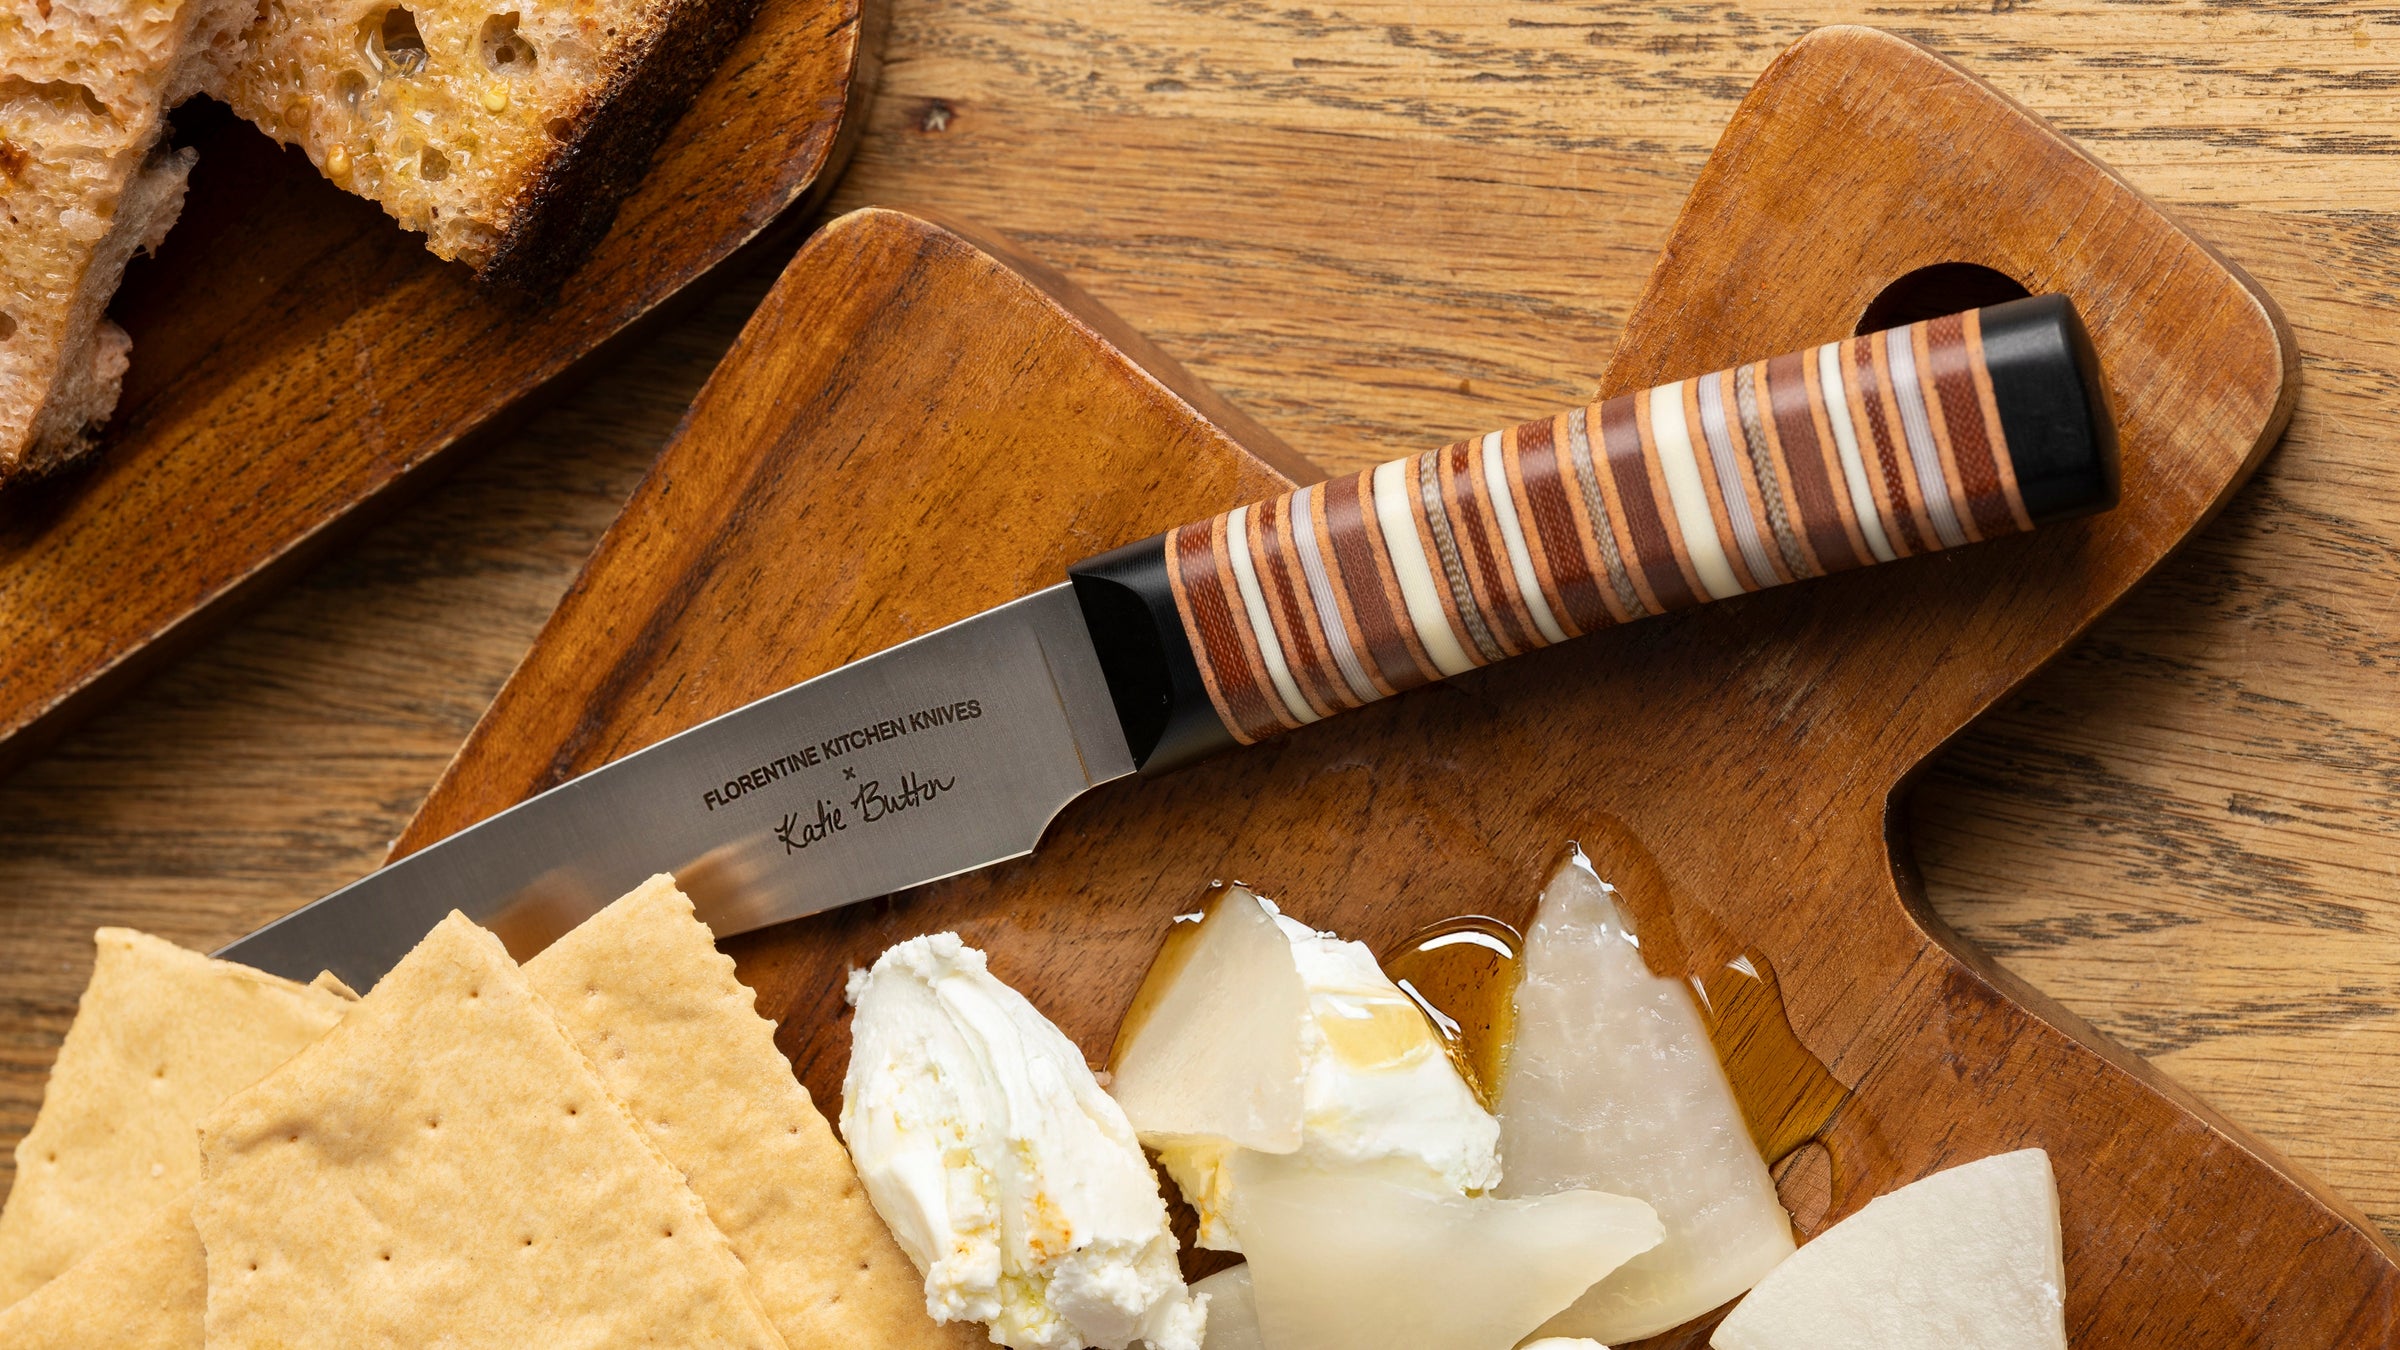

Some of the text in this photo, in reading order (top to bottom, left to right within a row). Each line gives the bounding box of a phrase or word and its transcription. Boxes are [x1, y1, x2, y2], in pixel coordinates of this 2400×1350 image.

[703, 699, 983, 811] FLORENTINE KITCHEN KNIVES
[774, 771, 955, 855] Katie Button
